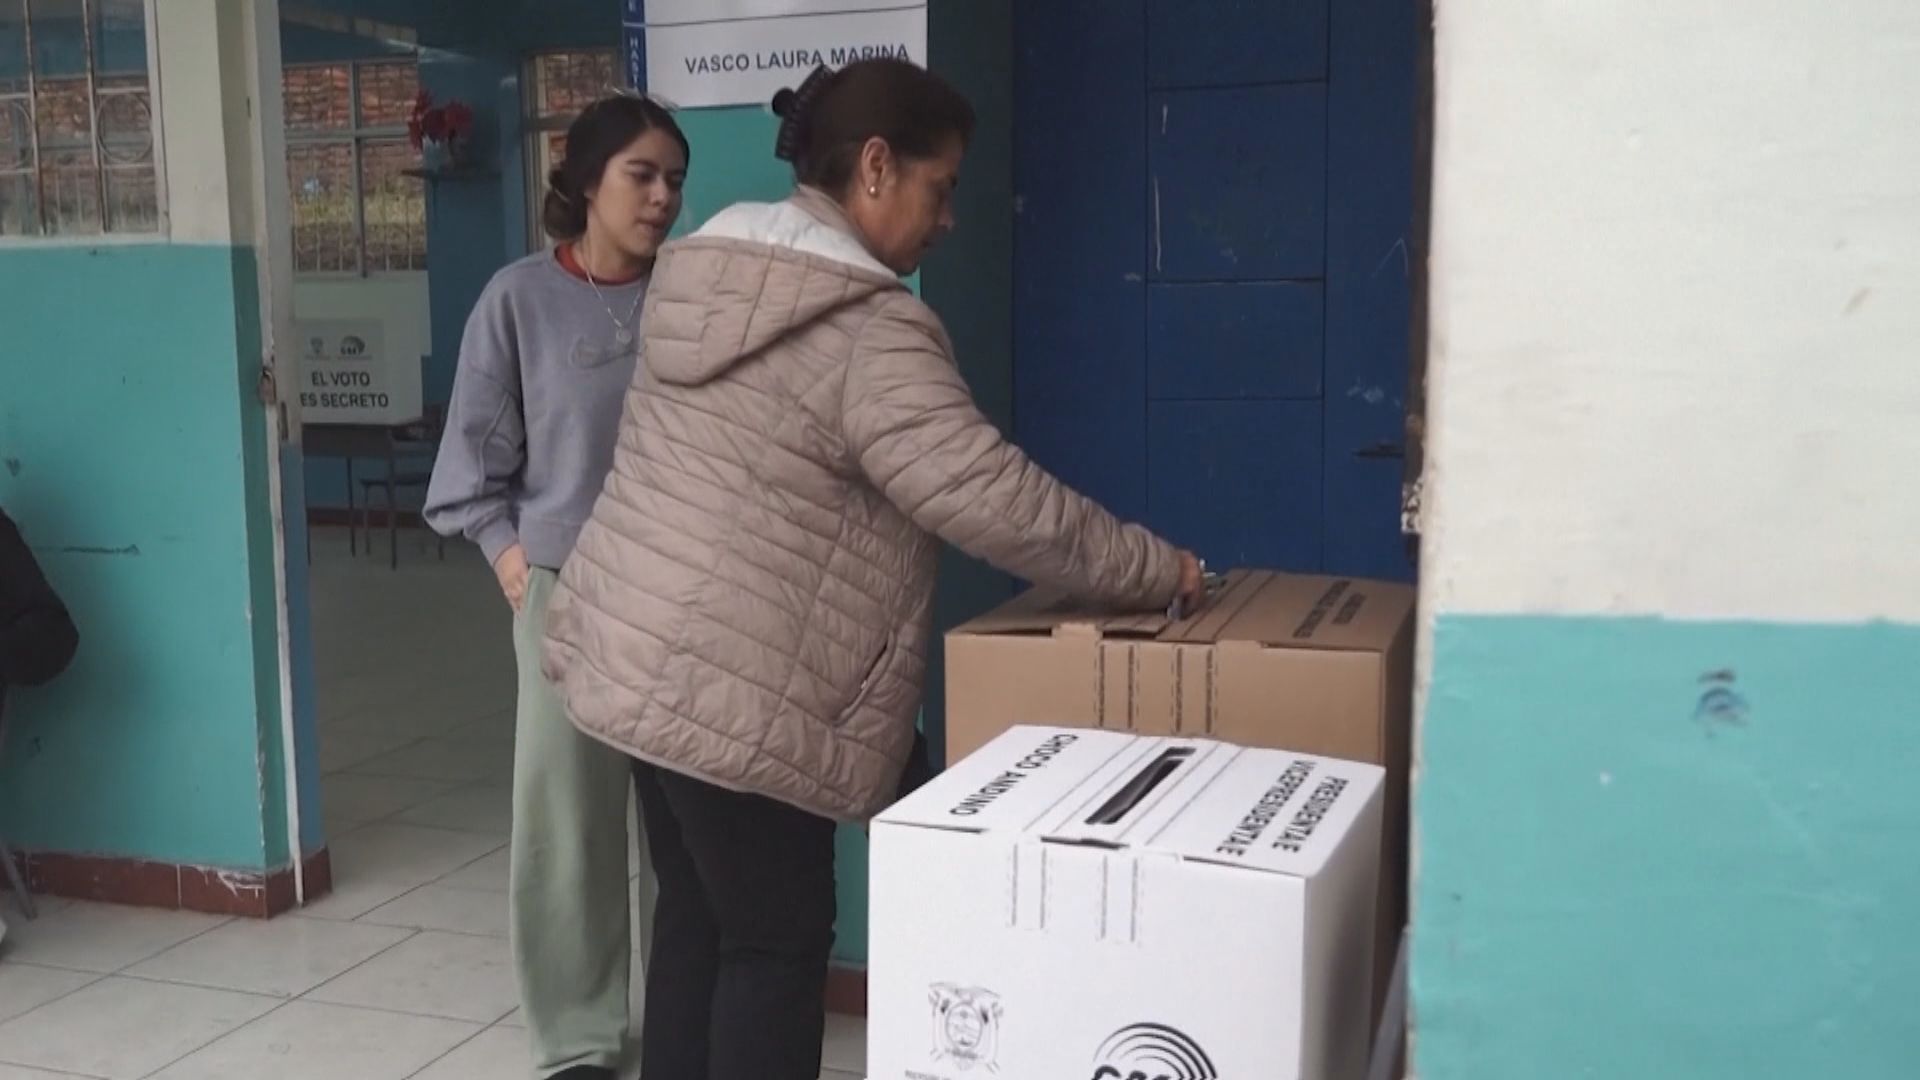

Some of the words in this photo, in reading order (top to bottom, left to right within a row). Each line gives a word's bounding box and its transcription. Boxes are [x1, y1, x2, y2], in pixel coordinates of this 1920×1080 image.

[685, 53, 749, 75] VASCO
[756, 47, 824, 70] LAURA
[830, 43, 909, 65] MARINA
[311, 371, 328, 387] EL
[330, 371, 370, 387] VOTO
[300, 392, 317, 407] ES
[320, 393, 389, 408] SECRETO
[949, 771, 1027, 815] ANDINO
